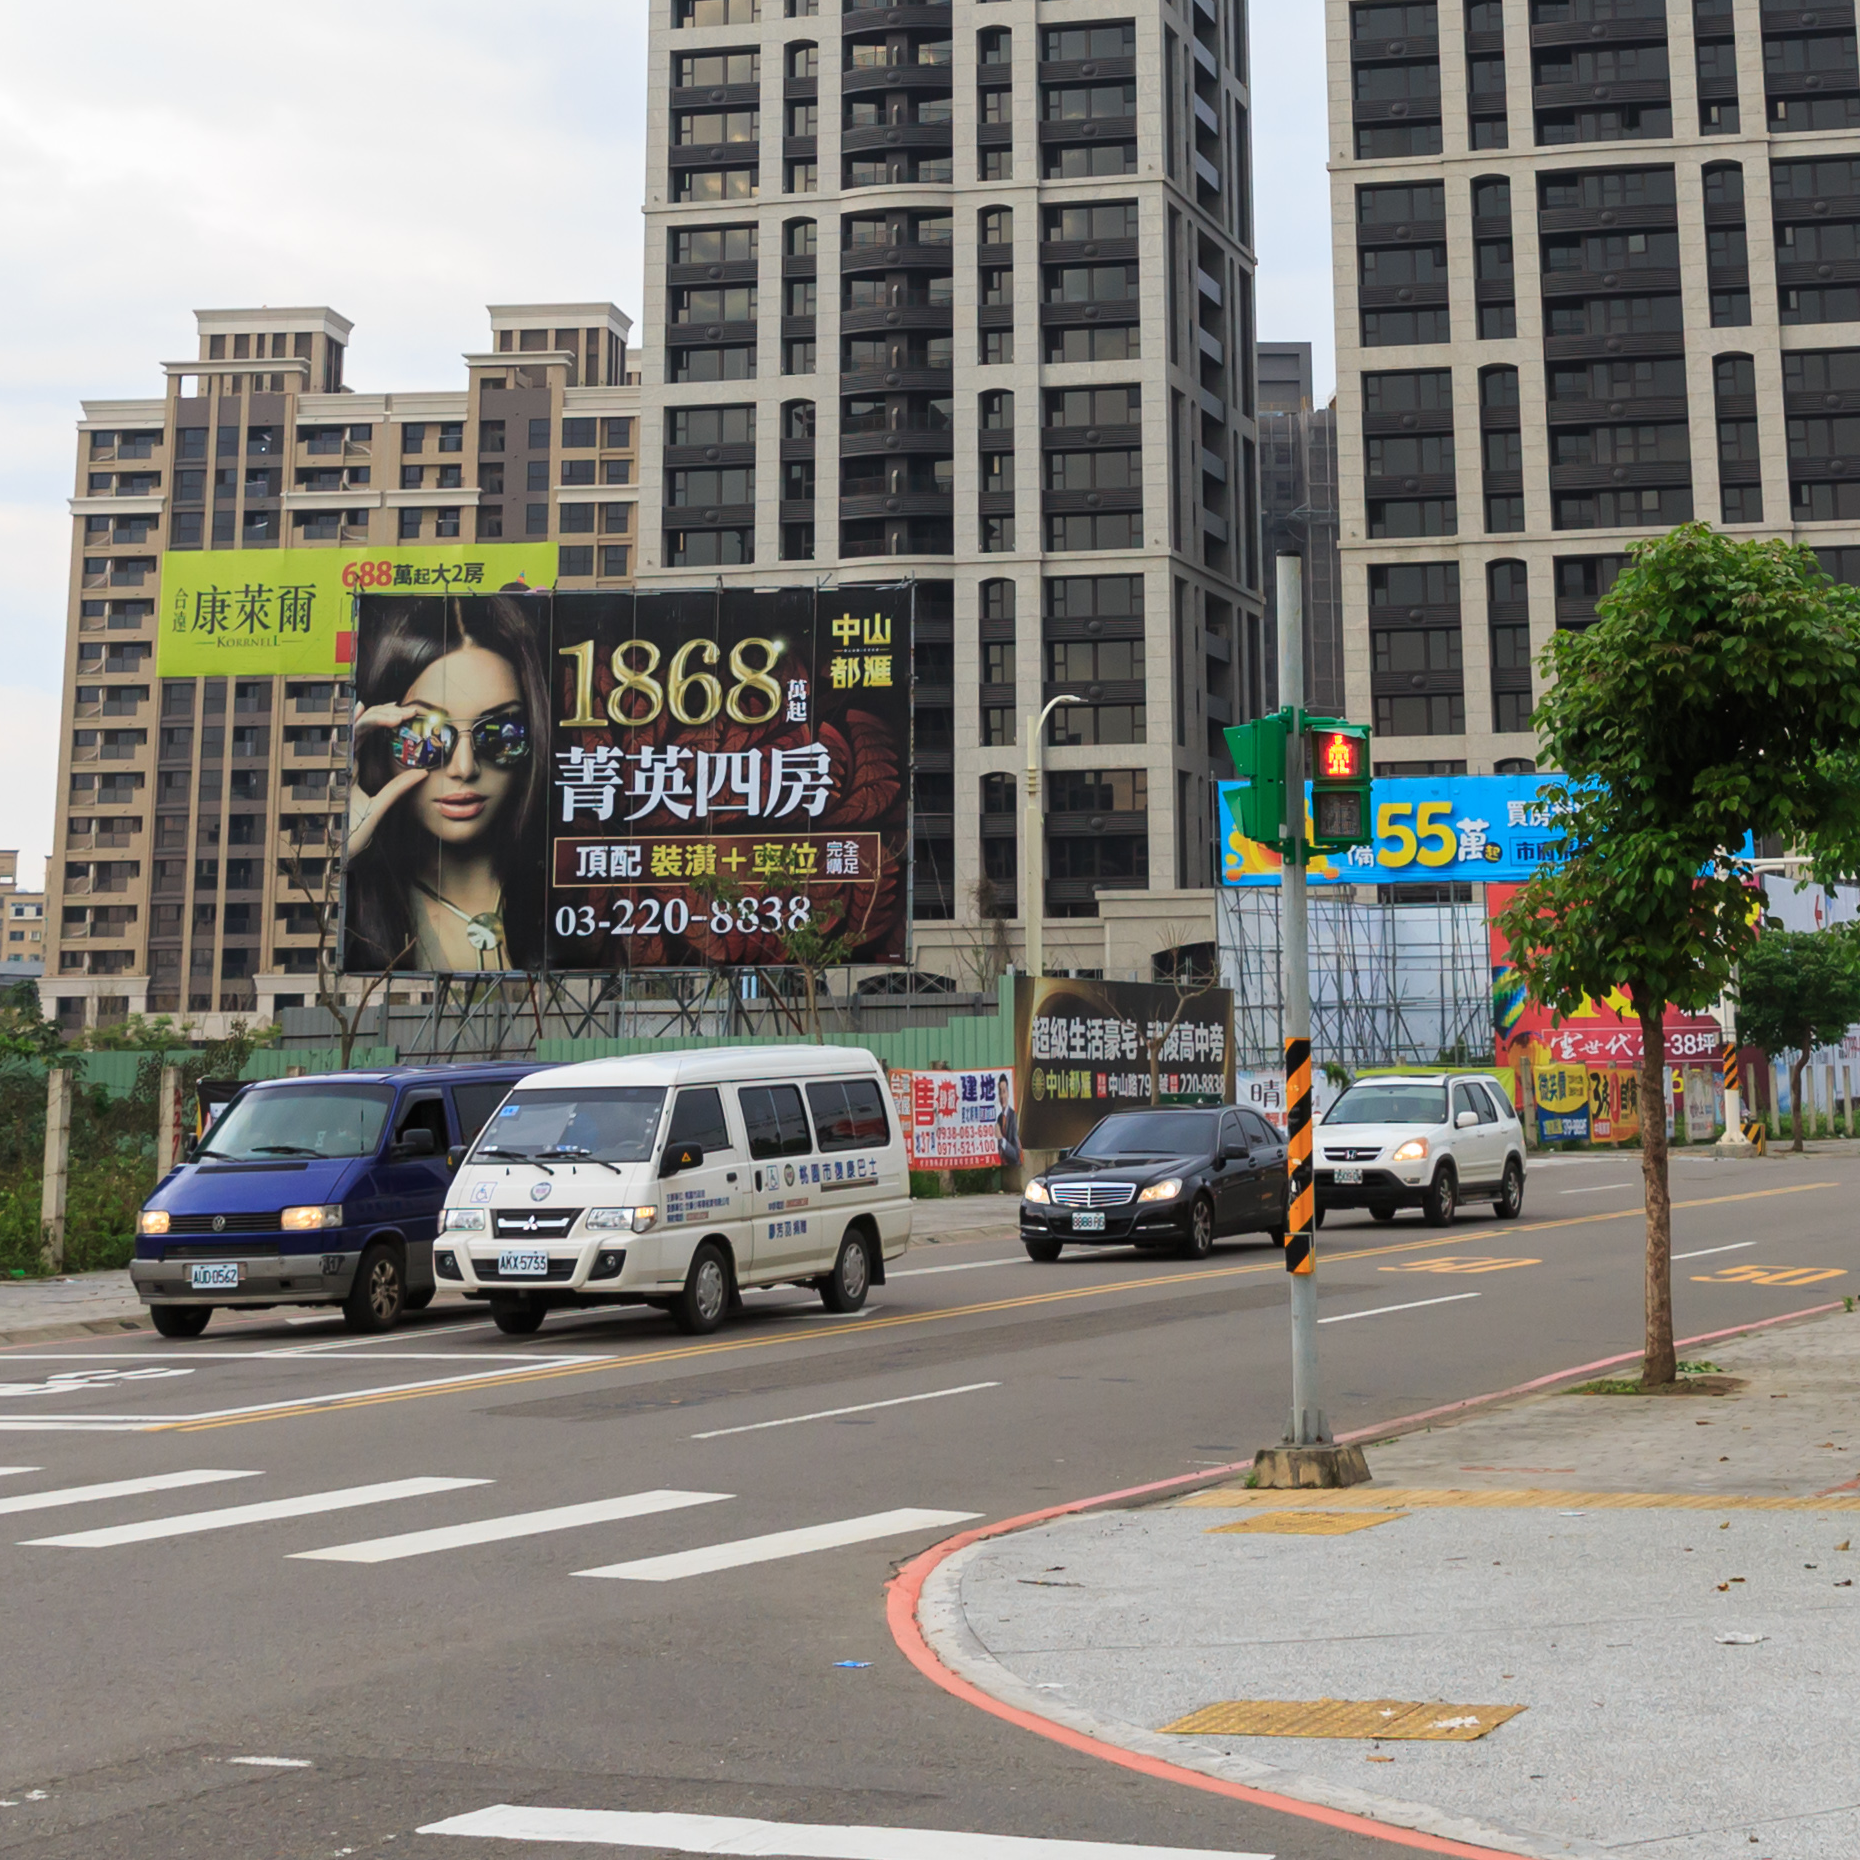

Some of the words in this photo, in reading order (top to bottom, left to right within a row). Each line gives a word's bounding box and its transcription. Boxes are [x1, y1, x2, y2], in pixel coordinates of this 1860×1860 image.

[341, 561, 485, 588] 688萬起大2房
[190, 583, 317, 635] 康萊爾
[831, 612, 892, 647] 中山
[558, 636, 783, 727] 1868
[555, 742, 834, 823] 菁英四房
[575, 844, 642, 878] 頂配
[555, 896, 812, 936] 03-220-8838
[960, 1073, 996, 1102] 建地
[499, 1255, 547, 1272] AKX-5733
[1690, 1264, 1849, 1286] 50
